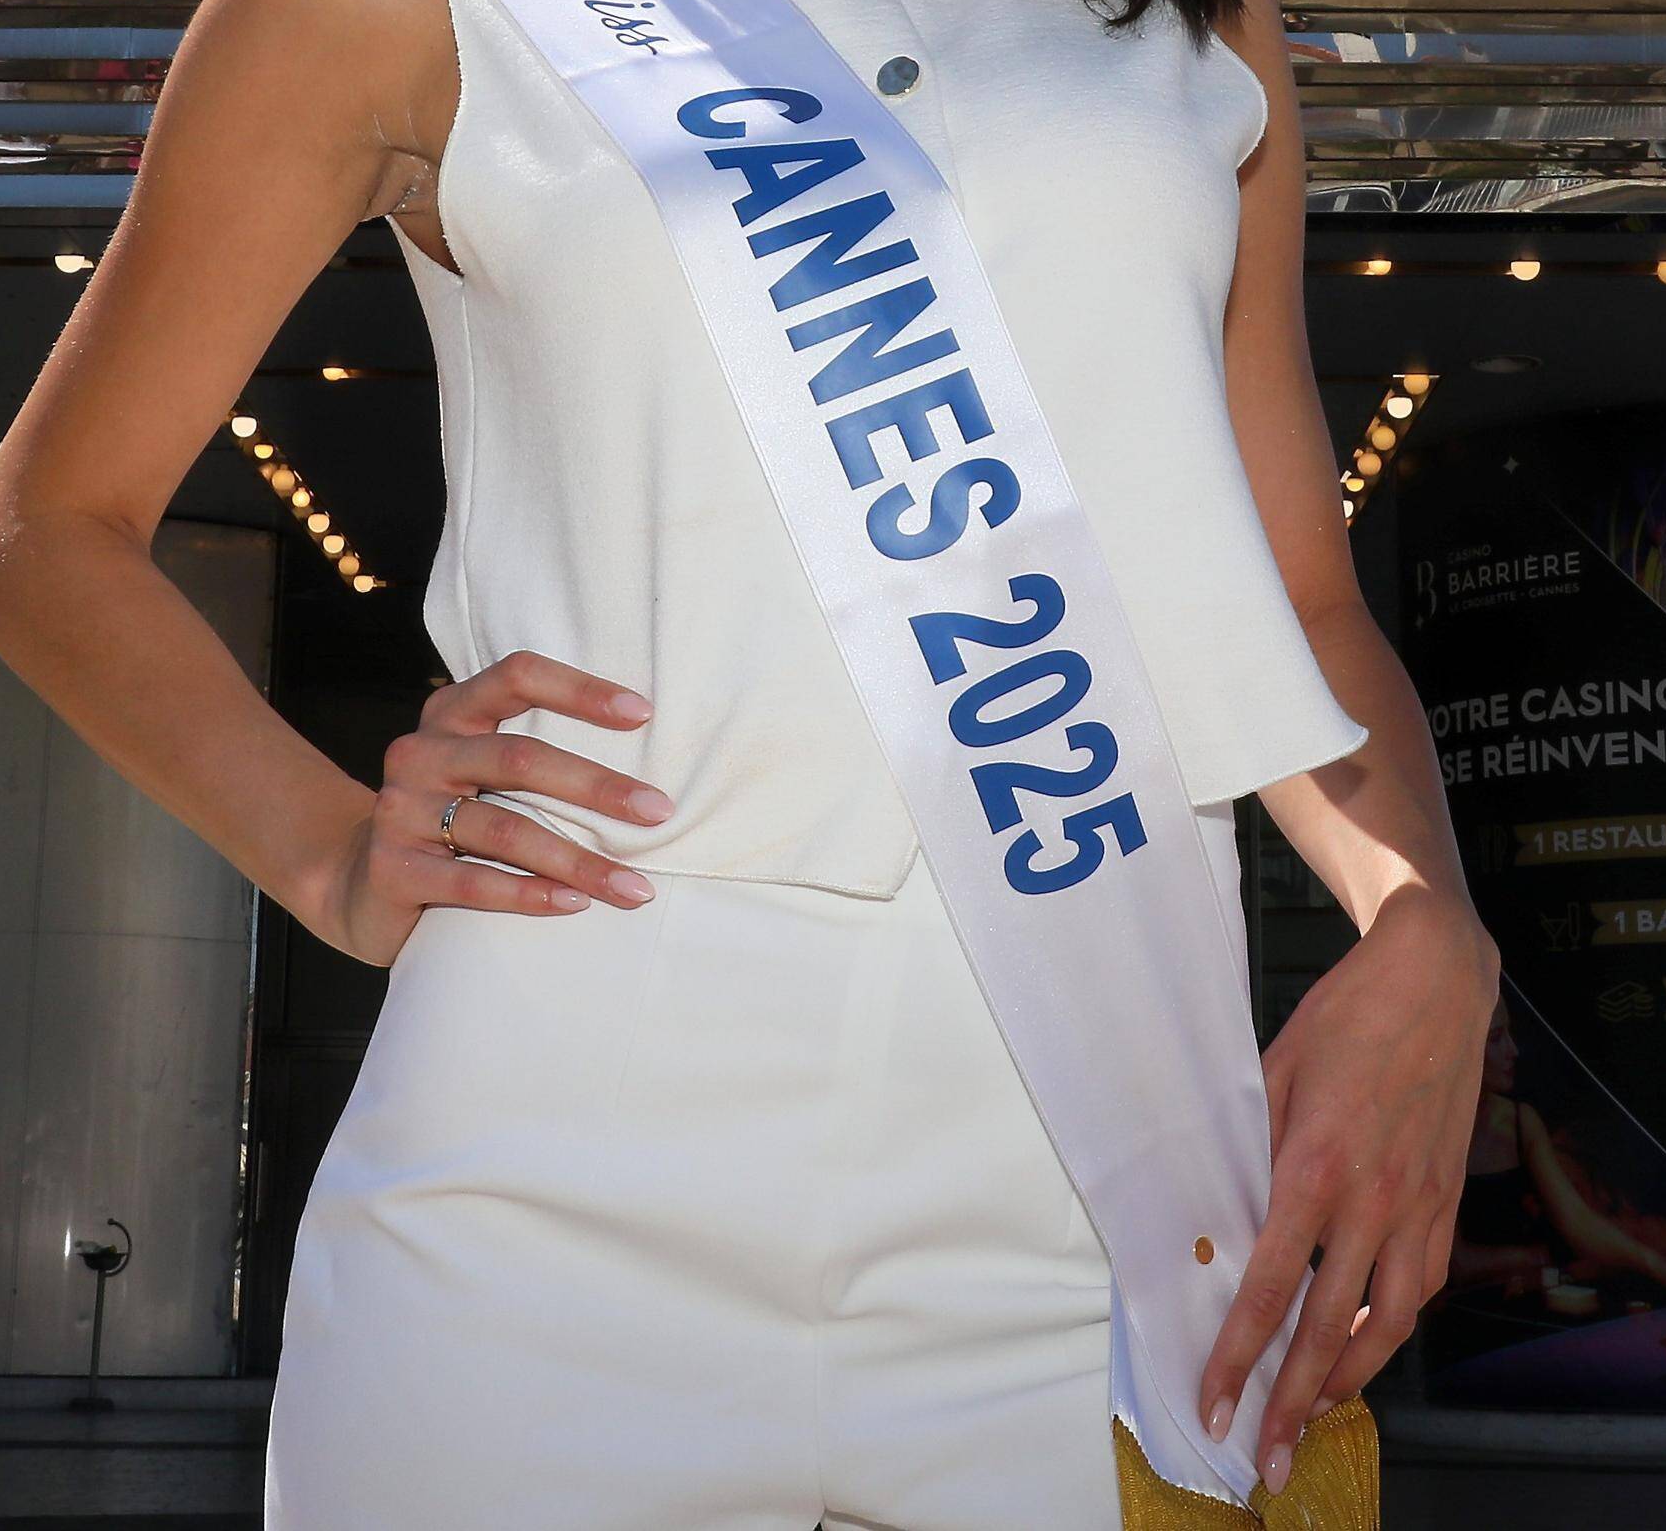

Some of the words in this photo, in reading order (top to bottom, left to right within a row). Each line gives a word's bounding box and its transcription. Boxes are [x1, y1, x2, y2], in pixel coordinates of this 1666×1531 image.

[675, 84, 1023, 563] CANNES
[908, 571, 1149, 897] 2025
[1447, 550, 1581, 596] BARRIÈRE
[1528, 582, 1581, 599] CANNES
[1440, 750, 1473, 787] SE
[1533, 831, 1544, 854] 1
[1615, 910, 1627, 934] 1
